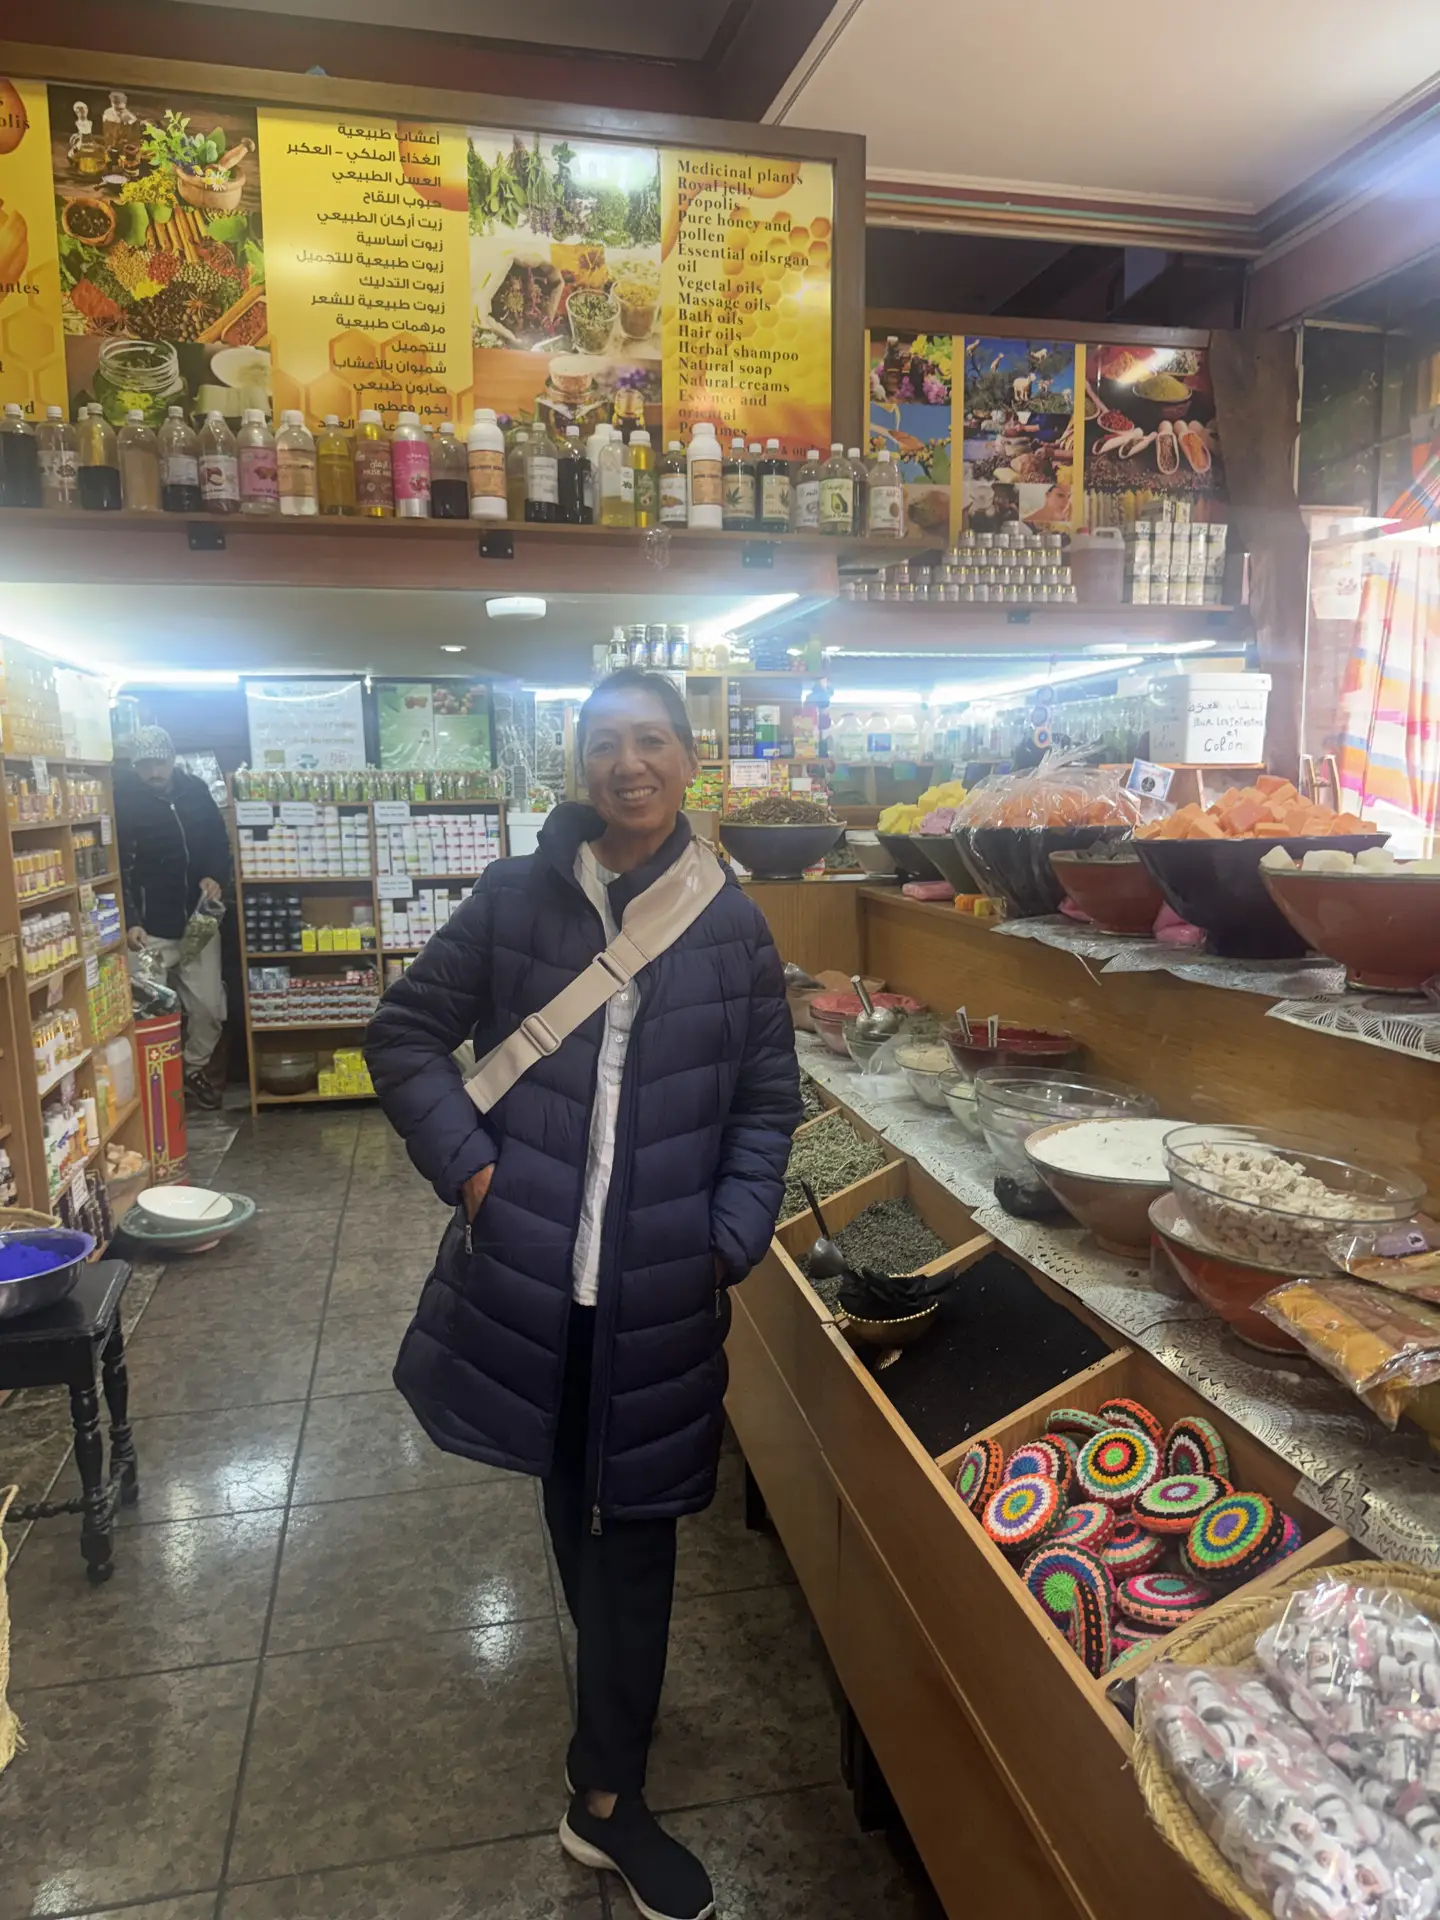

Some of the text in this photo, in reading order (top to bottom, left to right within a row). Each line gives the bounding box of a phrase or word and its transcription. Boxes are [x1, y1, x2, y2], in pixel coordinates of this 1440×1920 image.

[338, 123, 440, 144] أعشاب طبيعية
[287, 142, 332, 155] العكبر
[346, 148, 395, 163] الملكي
[399, 152, 440, 166] الغذاء
[332, 170, 441, 187] العسل الطبيعي
[678, 160, 803, 185] Medicinal plants
[678, 176, 754, 200] Royal jelly
[363, 191, 442, 209] حبوب اللقاح
[678, 193, 741, 212] Propolis
[317, 211, 442, 231] زيت أركان الطبيعي
[678, 210, 792, 233] Pure honey and
[356, 232, 443, 252] زيوت أساسية
[678, 228, 725, 243] pollen
[296, 250, 444, 273] زيوت طبيعية للتجميل
[678, 243, 809, 268] Essential oilsrgan
[678, 259, 697, 273] oil
[359, 276, 444, 293] زيوت التدليك
[678, 275, 763, 294] Vegetal oils
[311, 292, 445, 314] زيوت طبيعية للشعر
[678, 292, 771, 312] Massage oils
[336, 314, 445, 334] مرهمات طبيعية
[678, 308, 744, 325] Bath oils
[678, 325, 742, 341] Hair oils
[392, 340, 446, 353] للتجميل
[678, 341, 799, 363] Herbal shampoo
[333, 356, 393, 371] بالأعشاب
[678, 357, 772, 378] Natural soap
[353, 381, 447, 394] صابون طبيعي
[678, 373, 790, 392] Natural creams
[419, 404, 448, 415] بخور
[740, 394, 767, 407] and
[678, 407, 736, 421] oriental
